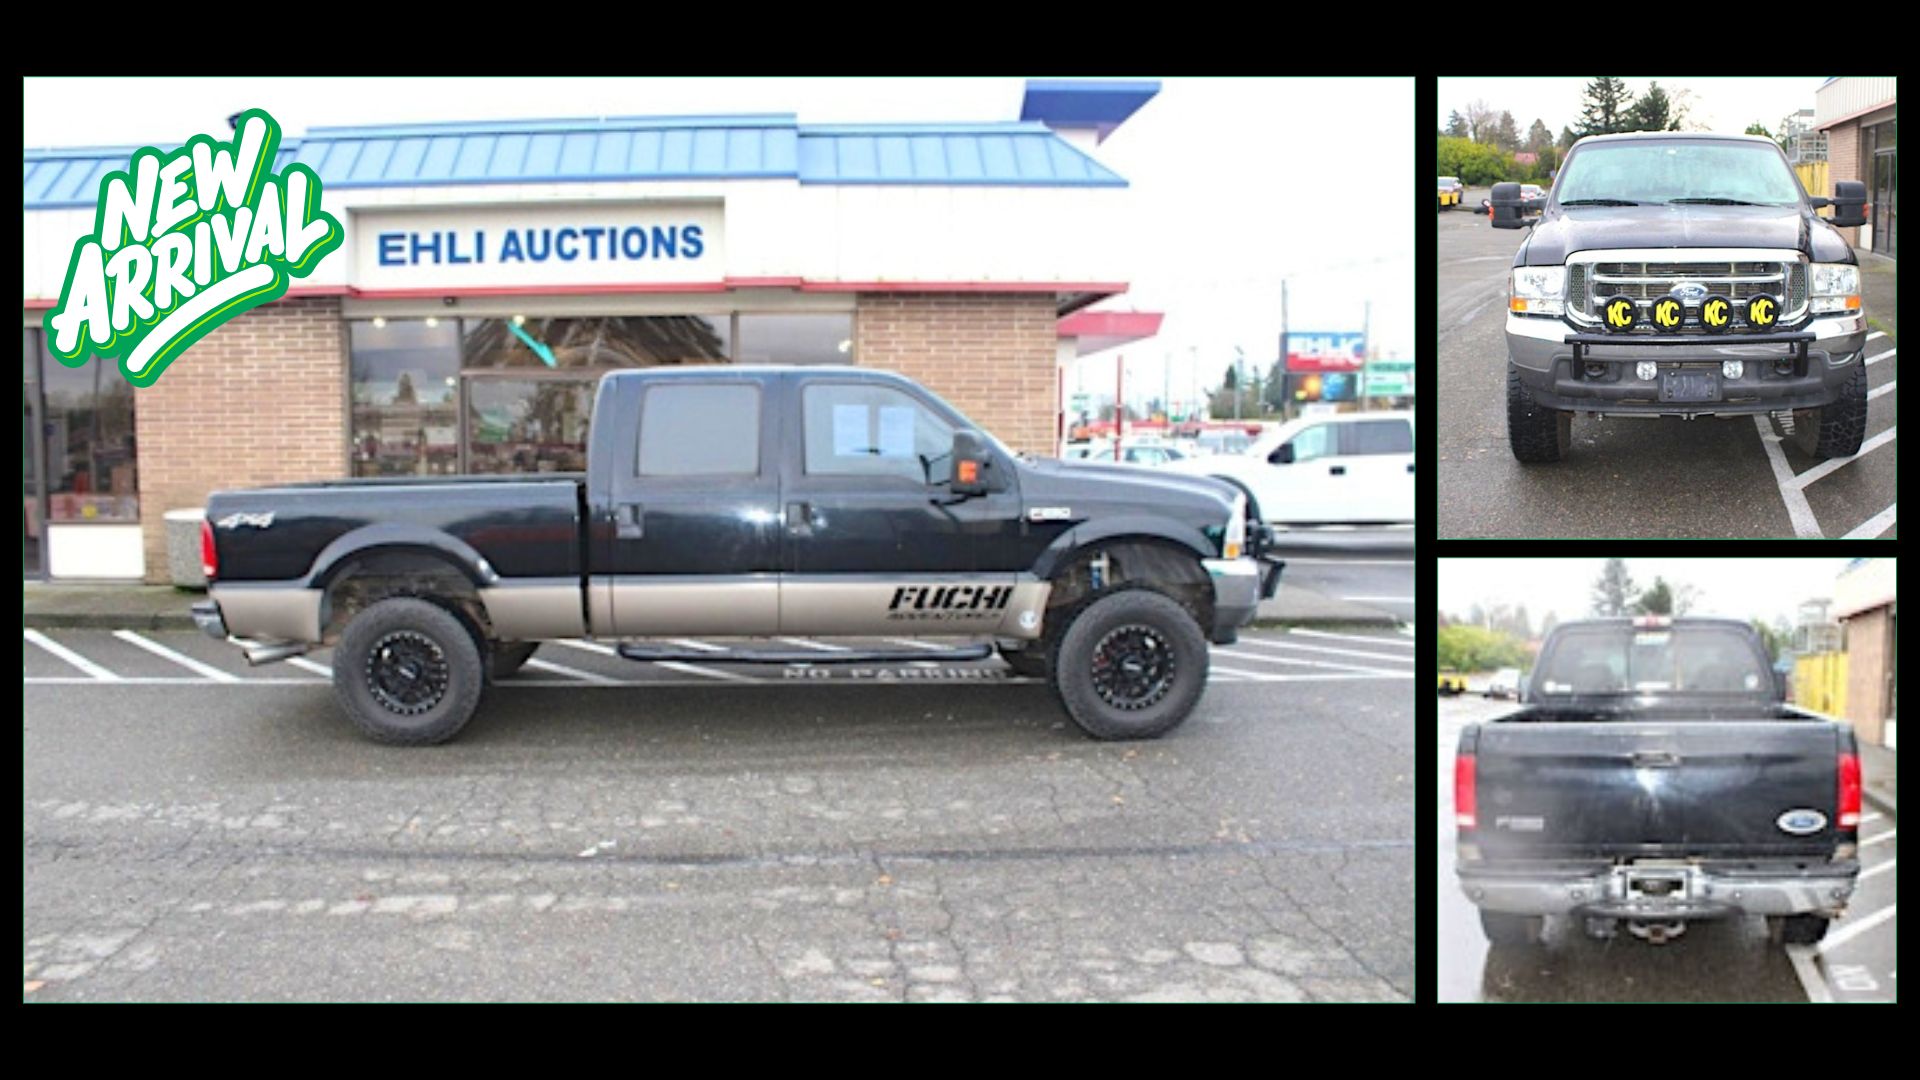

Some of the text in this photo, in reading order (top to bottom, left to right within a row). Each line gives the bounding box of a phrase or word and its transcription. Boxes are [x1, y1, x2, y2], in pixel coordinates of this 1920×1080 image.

[378, 225, 704, 267] EHLI AUCTIONS
[1606, 300, 1632, 327] KC
[1655, 300, 1680, 327] KC
[1704, 299, 1728, 327] KC
[1750, 298, 1774, 325] KC
[888, 586, 1015, 611] FUCHI
